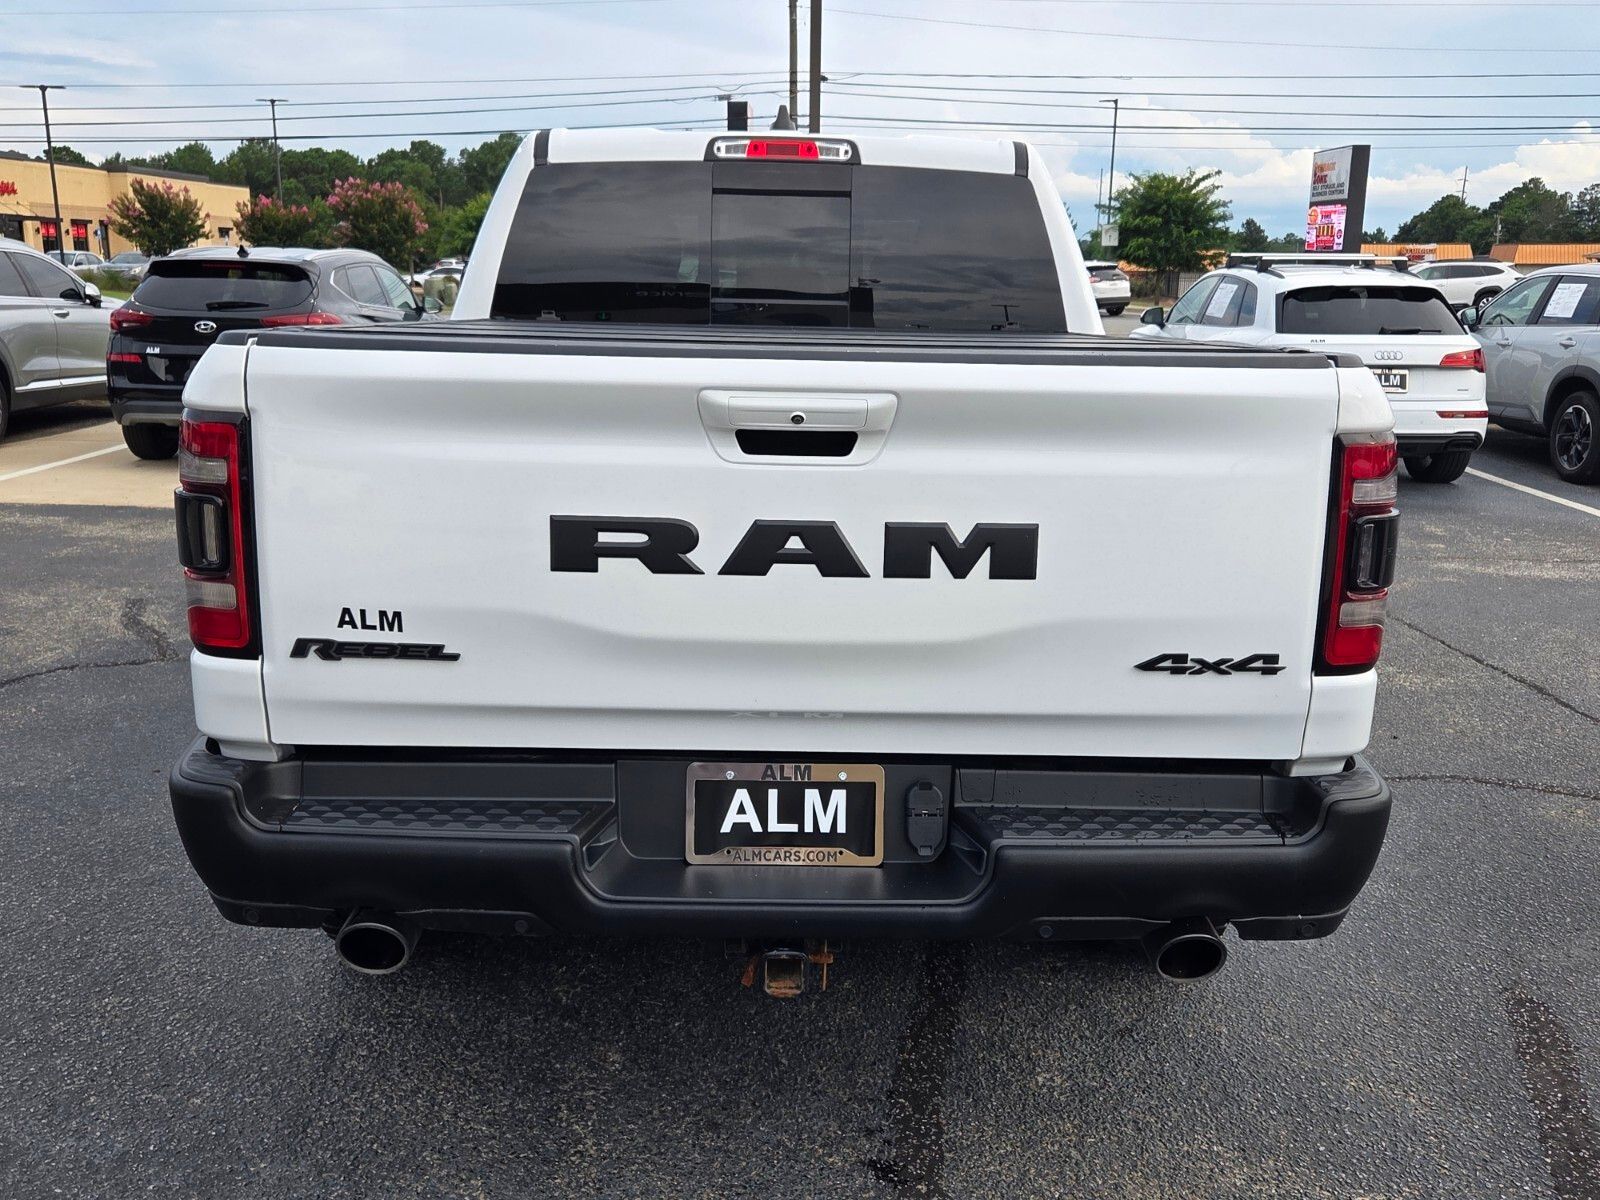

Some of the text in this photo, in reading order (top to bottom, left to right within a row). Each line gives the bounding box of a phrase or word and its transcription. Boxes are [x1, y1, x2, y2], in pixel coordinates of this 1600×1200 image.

[145, 346, 160, 354] ALM
[549, 514, 1040, 580] RAM
[337, 607, 404, 633] ALM
[289, 637, 461, 662] REBEL
[1133, 653, 1287, 676] 4x4
[761, 764, 812, 782] ALM
[719, 788, 847, 834] ALM
[732, 849, 838, 864] ALMCARS.COM
